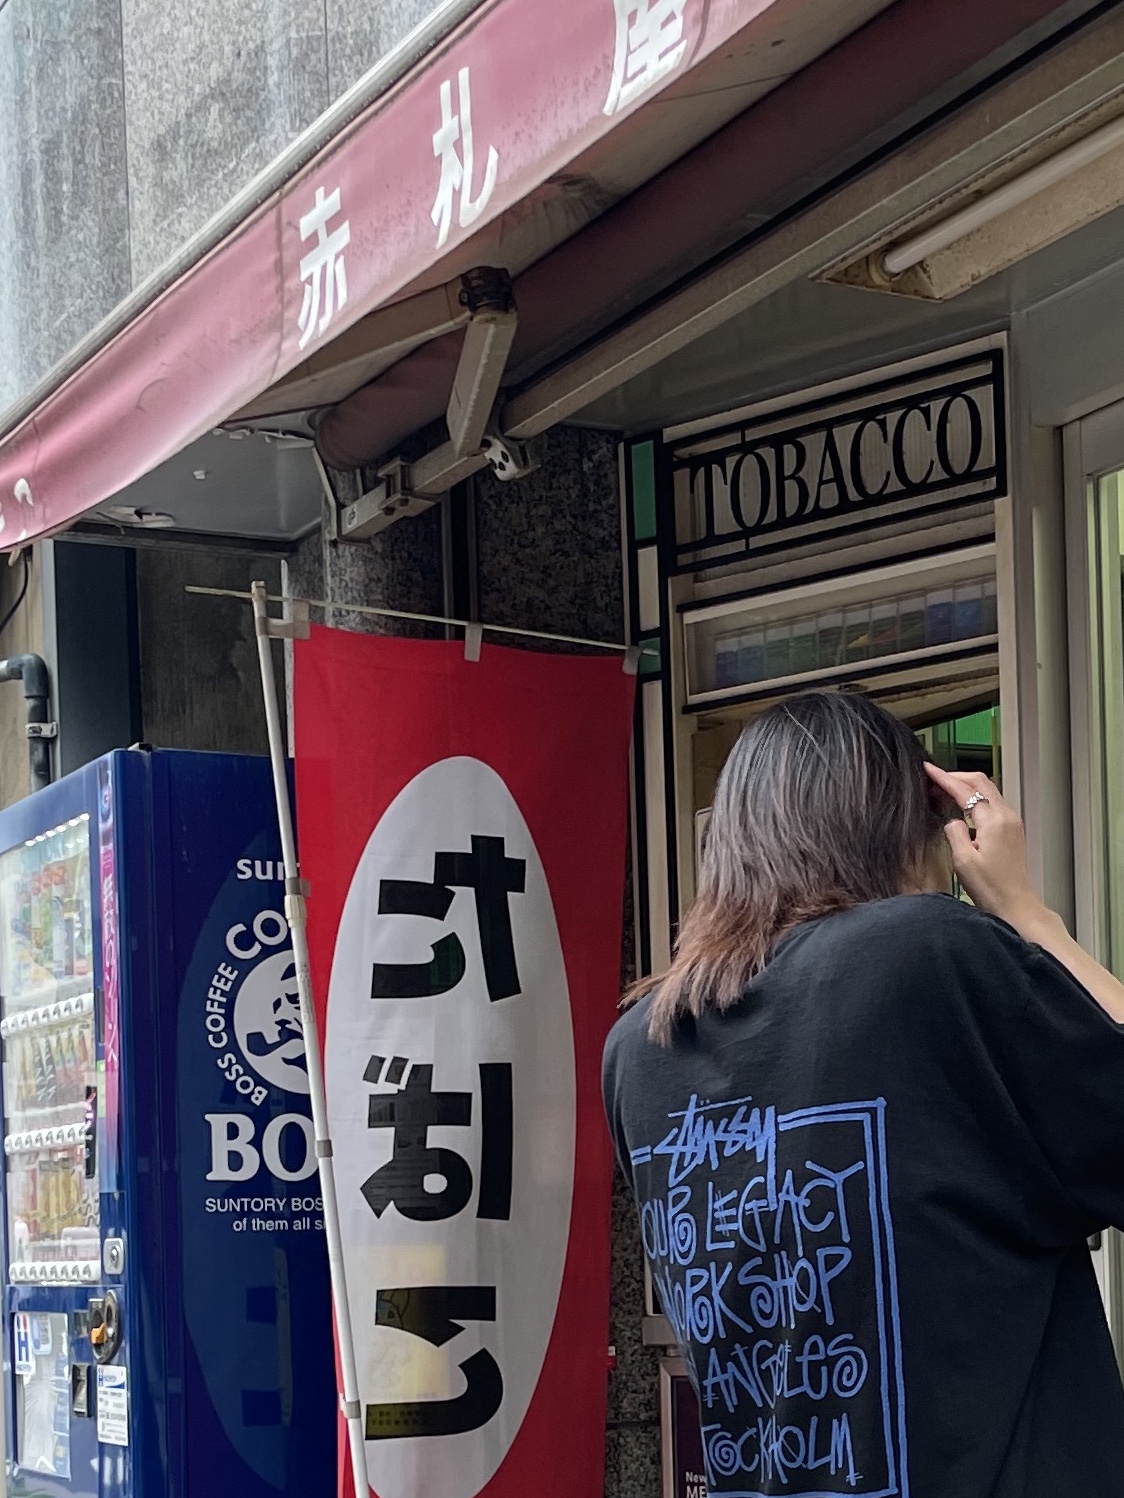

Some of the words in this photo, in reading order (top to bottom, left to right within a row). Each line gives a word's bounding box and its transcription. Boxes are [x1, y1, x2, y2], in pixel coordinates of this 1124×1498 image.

[690, 392, 983, 537] TOBACCO
[205, 962, 239, 1048] COFFEE
[217, 1052, 268, 1107] BOSS
[204, 1112, 320, 1182] BO
[205, 1198, 287, 1213] SUNTORY
[291, 1197, 325, 1212] BOS
[233, 1217, 247, 1232] of
[252, 1217, 288, 1231] them
[293, 1217, 310, 1230] all
[706, 1161, 865, 1257] LEGACY
[738, 1246, 852, 1329] SHOP
[701, 1413, 864, 1486] TOCKHOLM
